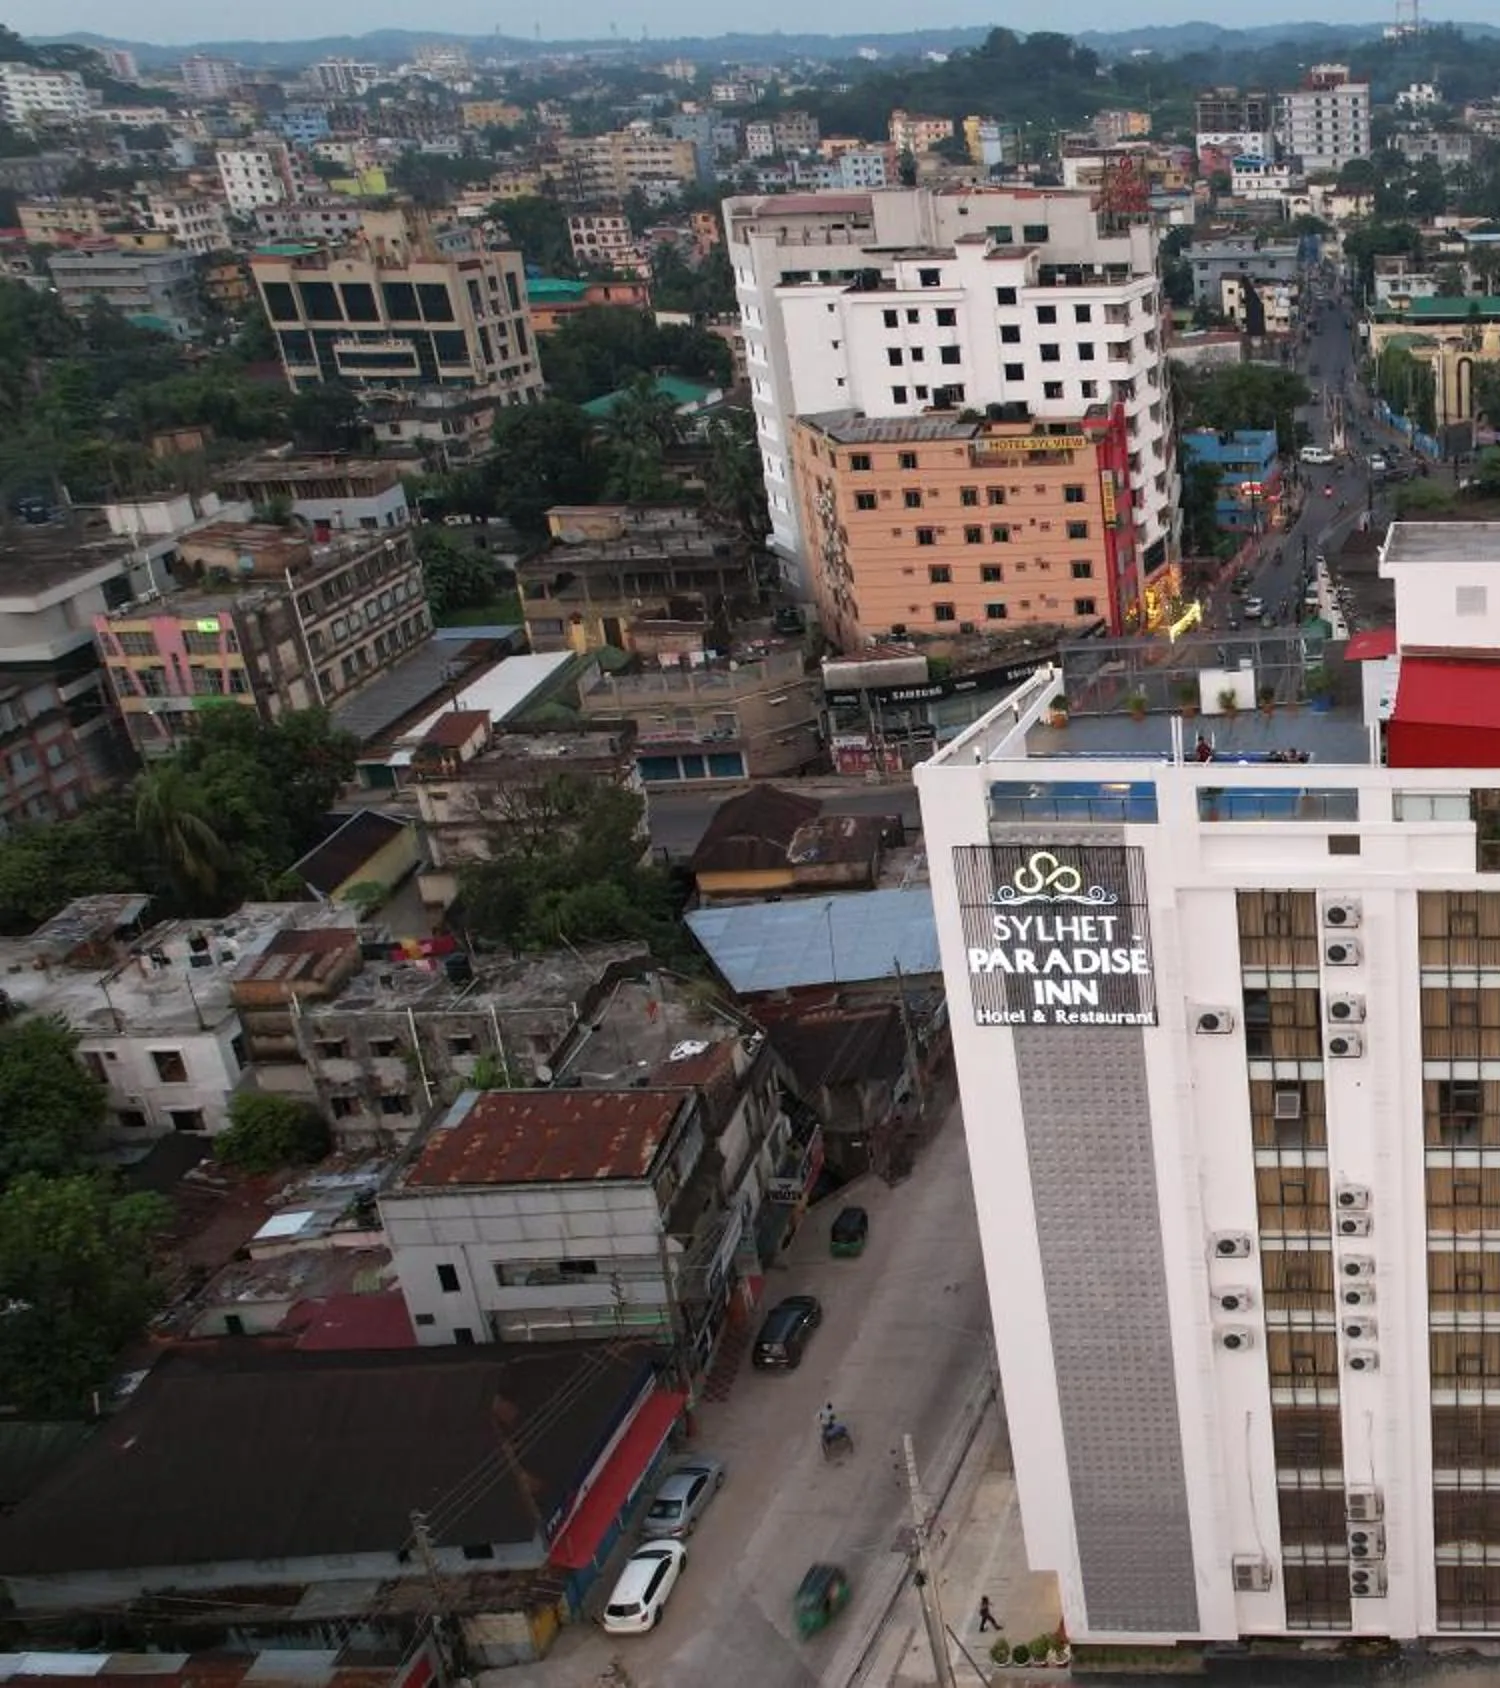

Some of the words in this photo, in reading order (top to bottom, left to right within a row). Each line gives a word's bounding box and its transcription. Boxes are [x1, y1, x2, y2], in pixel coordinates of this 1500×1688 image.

[989, 439, 1028, 450] HOTEL
[1054, 436, 1083, 449] VIEW
[993, 915, 1118, 942] SYLHET
[968, 948, 1151, 975] PARADISE
[1033, 979, 1099, 1005] INN
[977, 1009, 1026, 1023] Hotel
[1032, 1009, 1047, 1023] &
[1055, 1009, 1154, 1023] Restaurant
